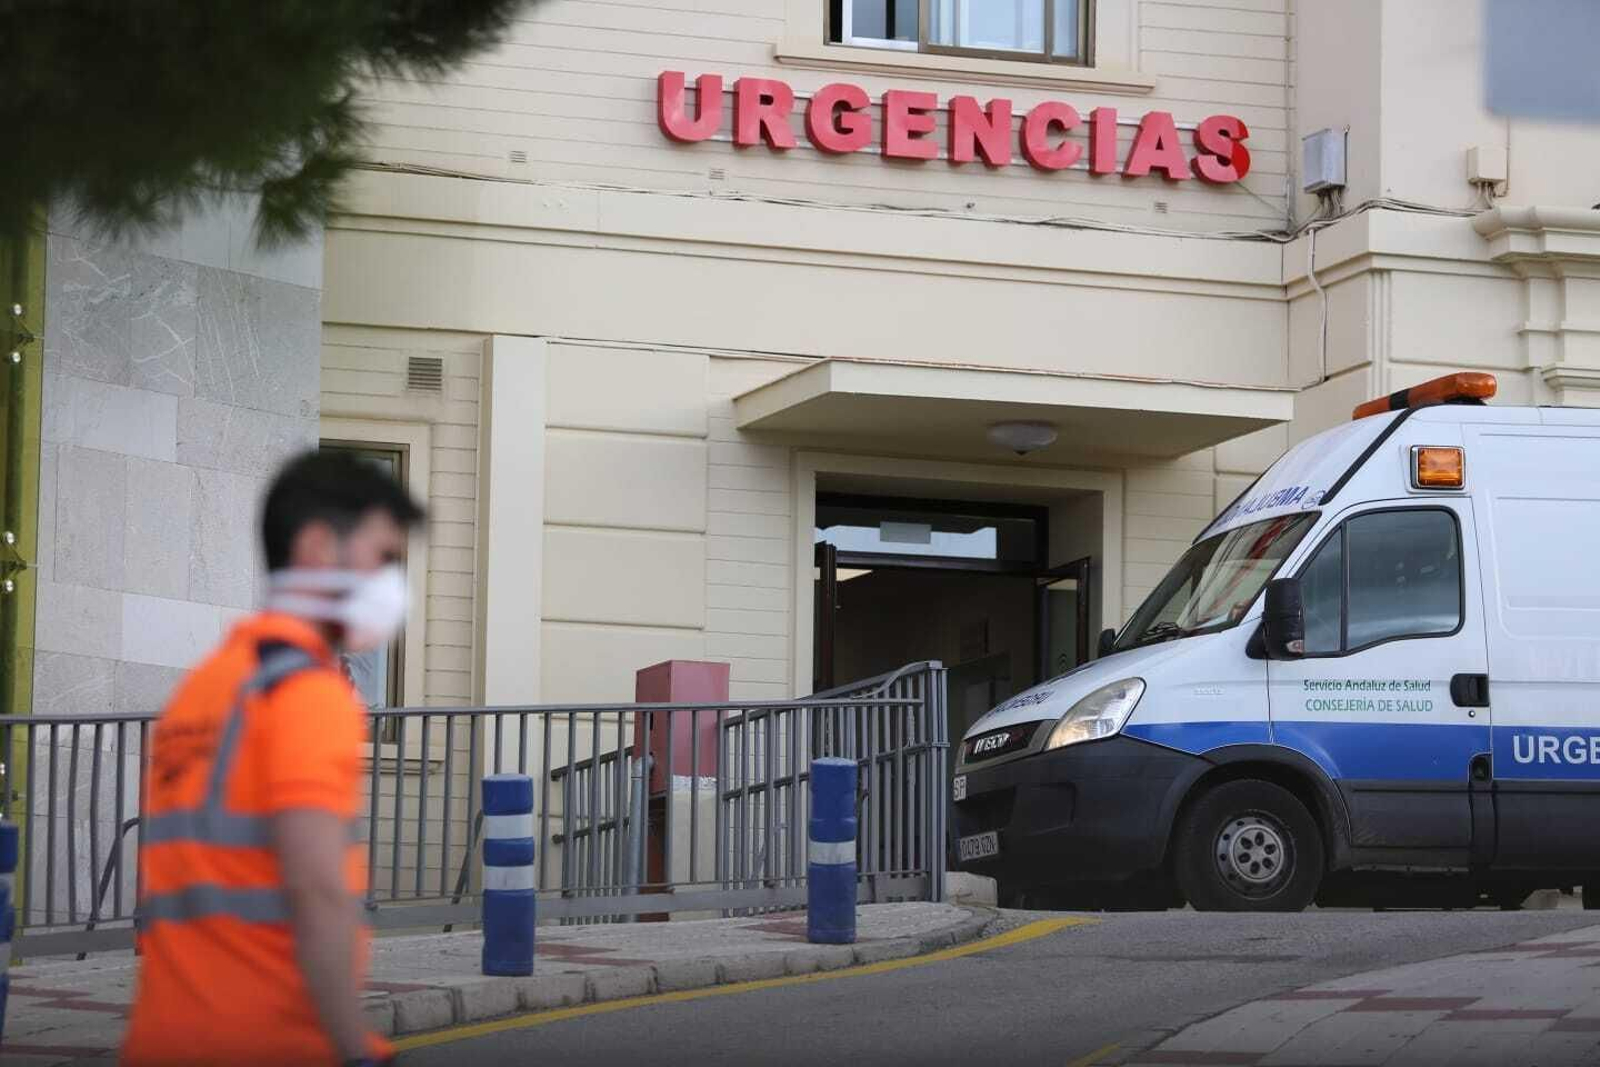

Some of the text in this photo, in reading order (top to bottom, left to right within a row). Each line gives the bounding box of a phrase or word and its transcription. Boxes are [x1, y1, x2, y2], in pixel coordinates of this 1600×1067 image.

[657, 71, 1251, 184] URGENCIAS
[1303, 679, 1432, 692] Servicio Andaluz de Salud
[1305, 697, 1434, 711] CONSEJERÍA DE SALUD
